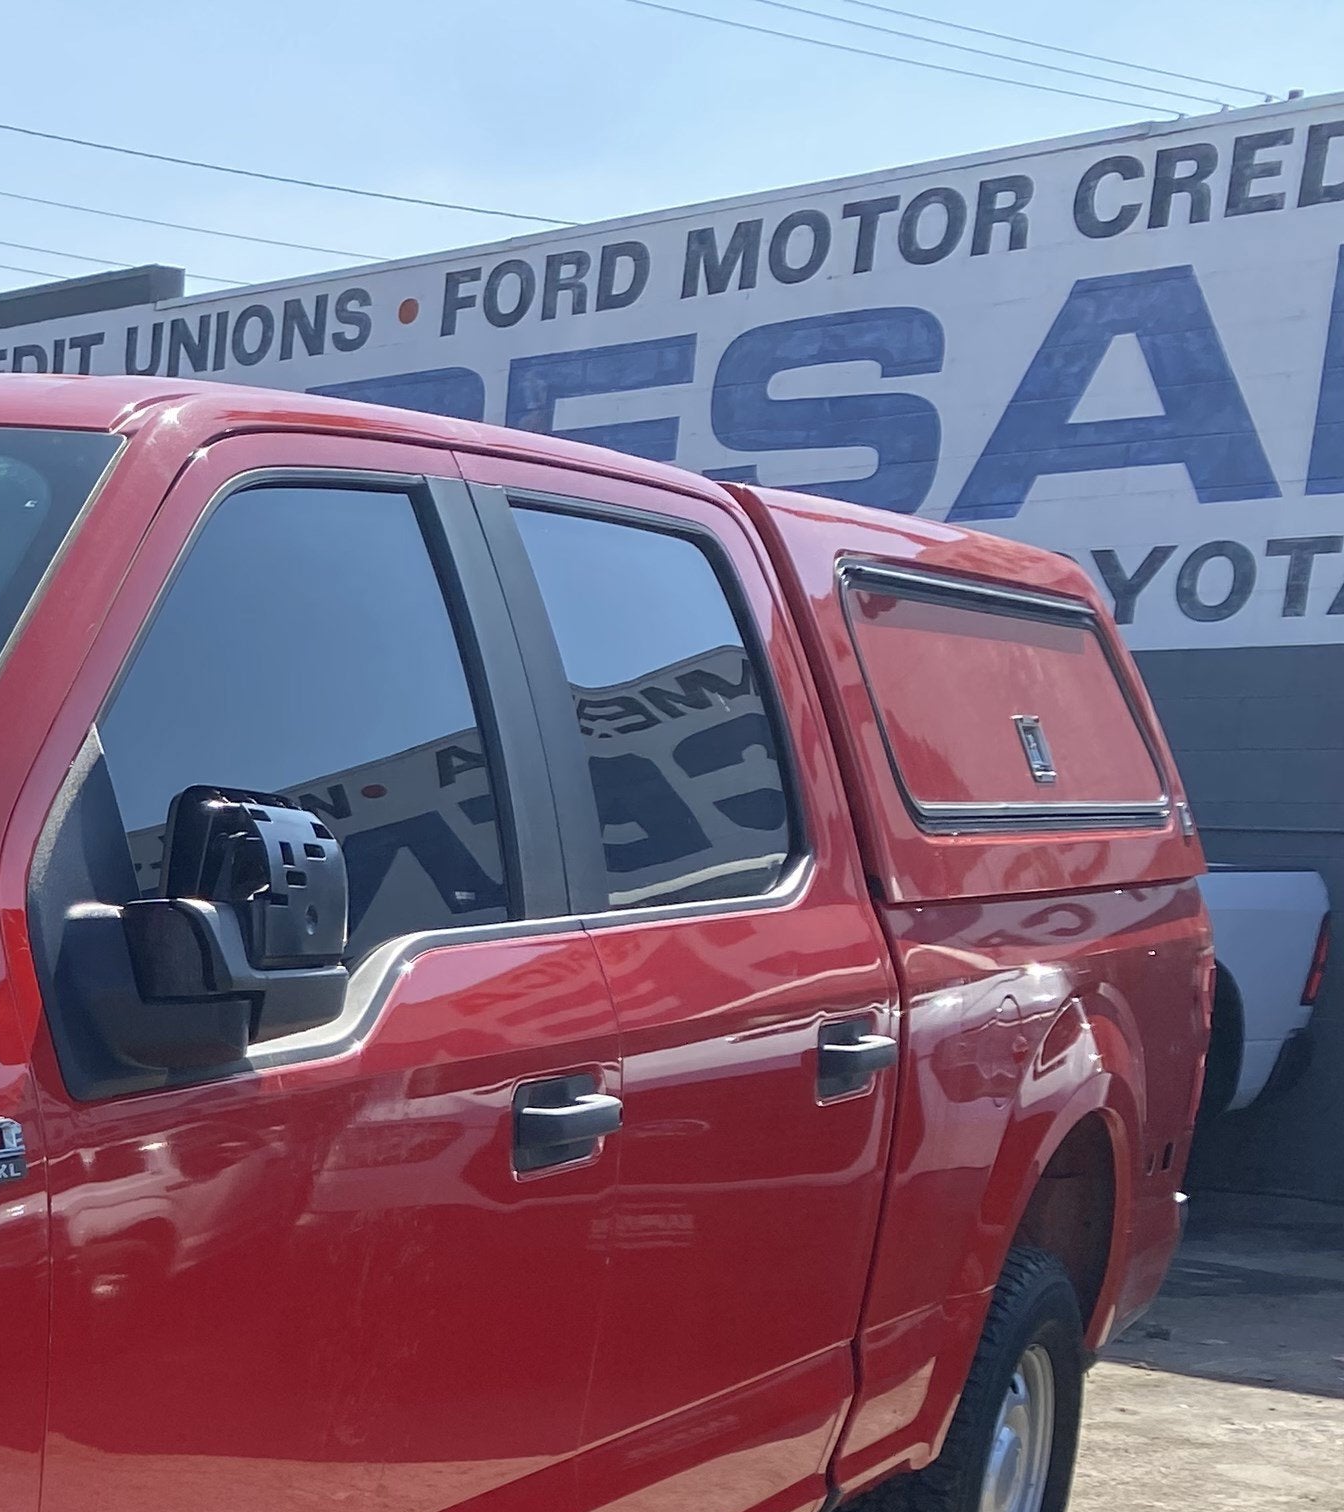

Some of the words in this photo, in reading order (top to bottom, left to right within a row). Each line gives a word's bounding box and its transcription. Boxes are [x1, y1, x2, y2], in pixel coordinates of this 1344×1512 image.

[125, 287, 373, 378] UNIONS
[440, 241, 650, 338] FORD
[680, 174, 1036, 300] MOTOR
[302, 244, 1344, 523] ESA
[1057, 535, 1344, 625] YOT
